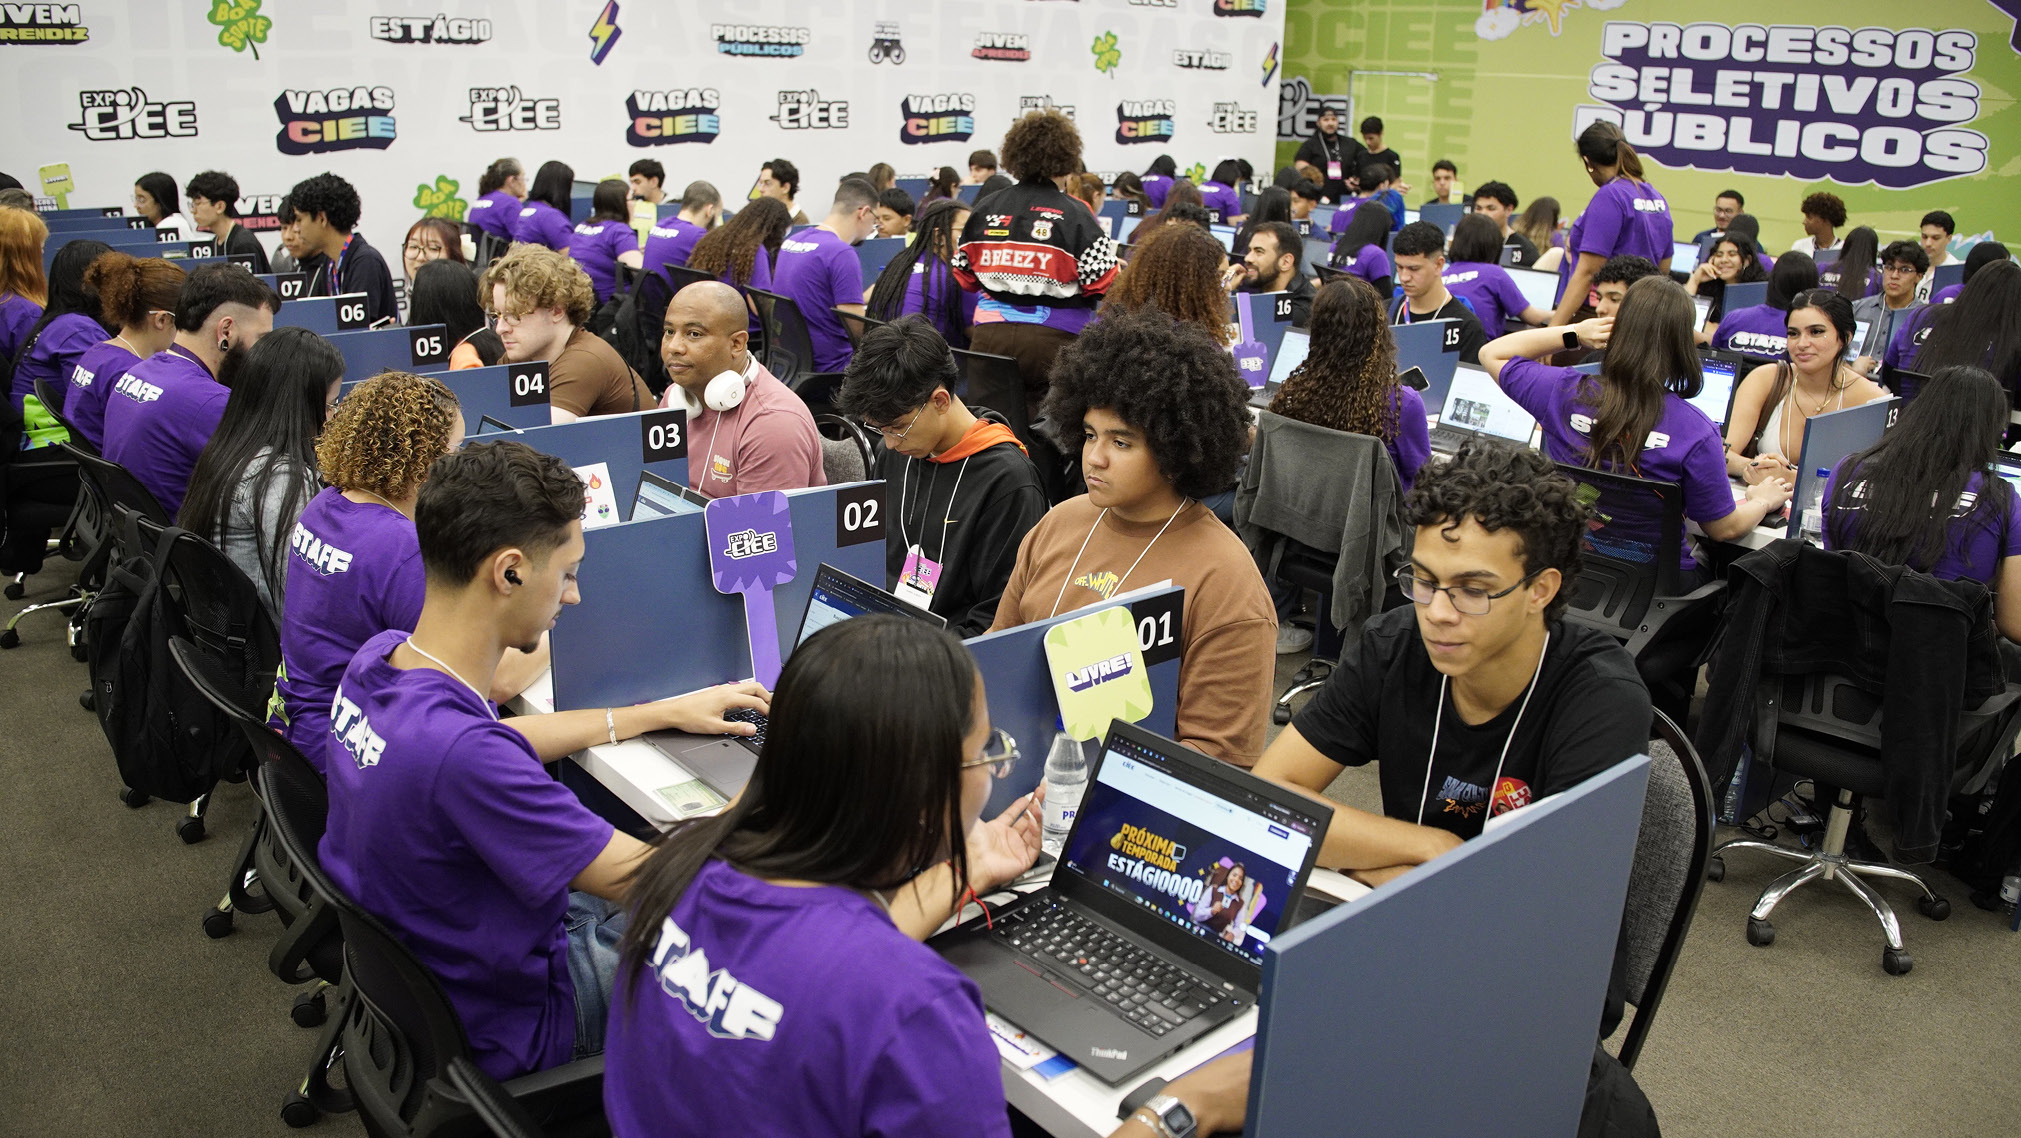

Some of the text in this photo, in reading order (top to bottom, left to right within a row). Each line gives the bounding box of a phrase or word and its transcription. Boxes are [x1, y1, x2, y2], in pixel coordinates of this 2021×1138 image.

[0, 4, 81, 24] VEM
[0, 27, 89, 40] RENDIZ
[222, 18, 268, 48] SORTE
[370, 14, 493, 41] ESTÁGIO
[711, 24, 811, 44] PROCESSOS
[718, 41, 804, 56] PÚBLICOS
[1602, 22, 1976, 72] PROCESSOS
[81, 90, 131, 107] EXPO
[285, 86, 394, 114] VAGAS
[470, 88, 509, 103] EXPO
[634, 88, 719, 112] VAGAS
[779, 91, 809, 104] EXPO
[1590, 63, 1980, 122] SELETIVOS
[470, 99, 560, 131] CIEE
[779, 101, 849, 129] CIEE
[908, 94, 975, 114] VAGAS
[1121, 100, 1175, 117] VAGAS
[82, 100, 198, 140] CIEE
[287, 115, 396, 144] CIEE
[634, 114, 720, 138] CIEE
[907, 116, 974, 136] CIEE
[1121, 120, 1174, 137] CIEE
[1212, 111, 1257, 133] CIEE
[420, 182, 455, 207] BOA
[131, 221, 146, 230] 11
[158, 232, 177, 243] 10
[192, 245, 212, 260] 09
[980, 248, 1053, 270] BREEZY
[279, 279, 303, 298] 07
[340, 302, 365, 324] 06
[1276, 300, 1291, 316] 16
[415, 336, 442, 357] 05
[1445, 328, 1460, 345] 15
[117, 372, 165, 402] STAFF
[514, 373, 545, 397] 04
[1886, 407, 1898, 429] 13
[648, 423, 681, 450] 03
[843, 499, 879, 532] 02
[292, 522, 353, 576] STAFF
[730, 533, 749, 543] EXPO
[731, 534, 776, 558] CIEE
[1138, 611, 1174, 651] 01
[1065, 652, 1134, 690] LIVRE!
[1120, 822, 1176, 855] PRÓXIMA
[1121, 840, 1178, 873] TEMPORADA
[648, 916, 784, 1041] TAFF
[1091, 1046, 1128, 1061] ThinkPad
